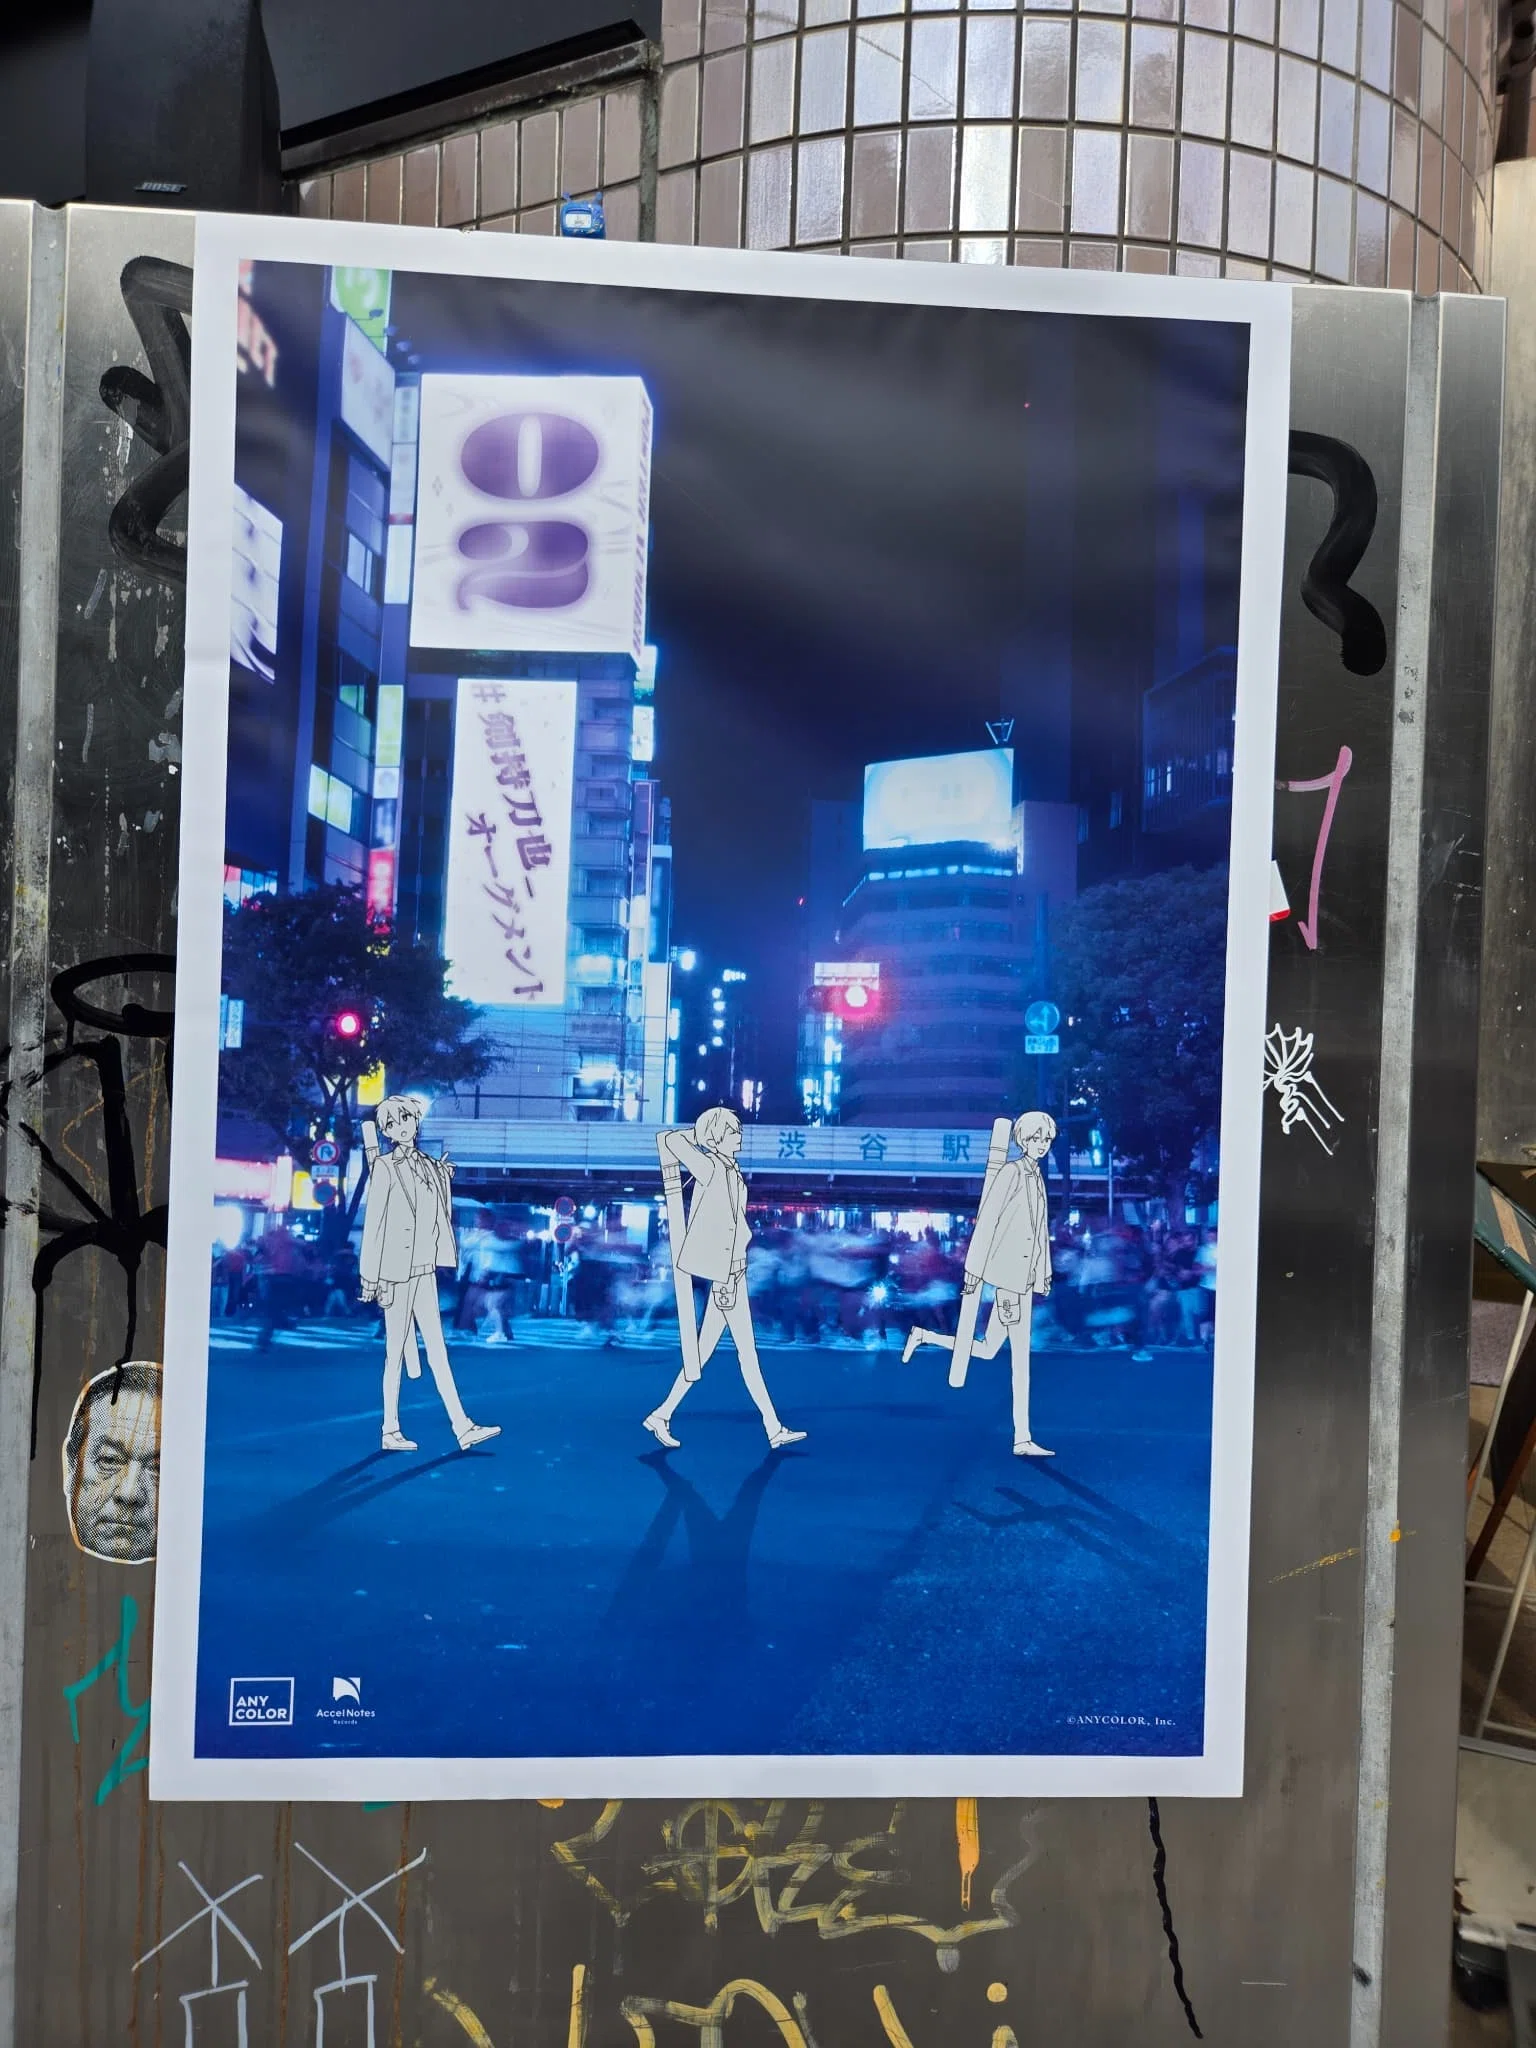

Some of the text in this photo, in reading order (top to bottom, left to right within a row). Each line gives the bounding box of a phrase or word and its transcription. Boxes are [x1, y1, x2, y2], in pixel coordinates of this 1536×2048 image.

[777, 1130, 971, 1162] 渋谷駅
[236, 1695, 269, 1707] ANY
[235, 1708, 287, 1720] COLOR
[1155, 1717, 1176, 1726] Inc.
